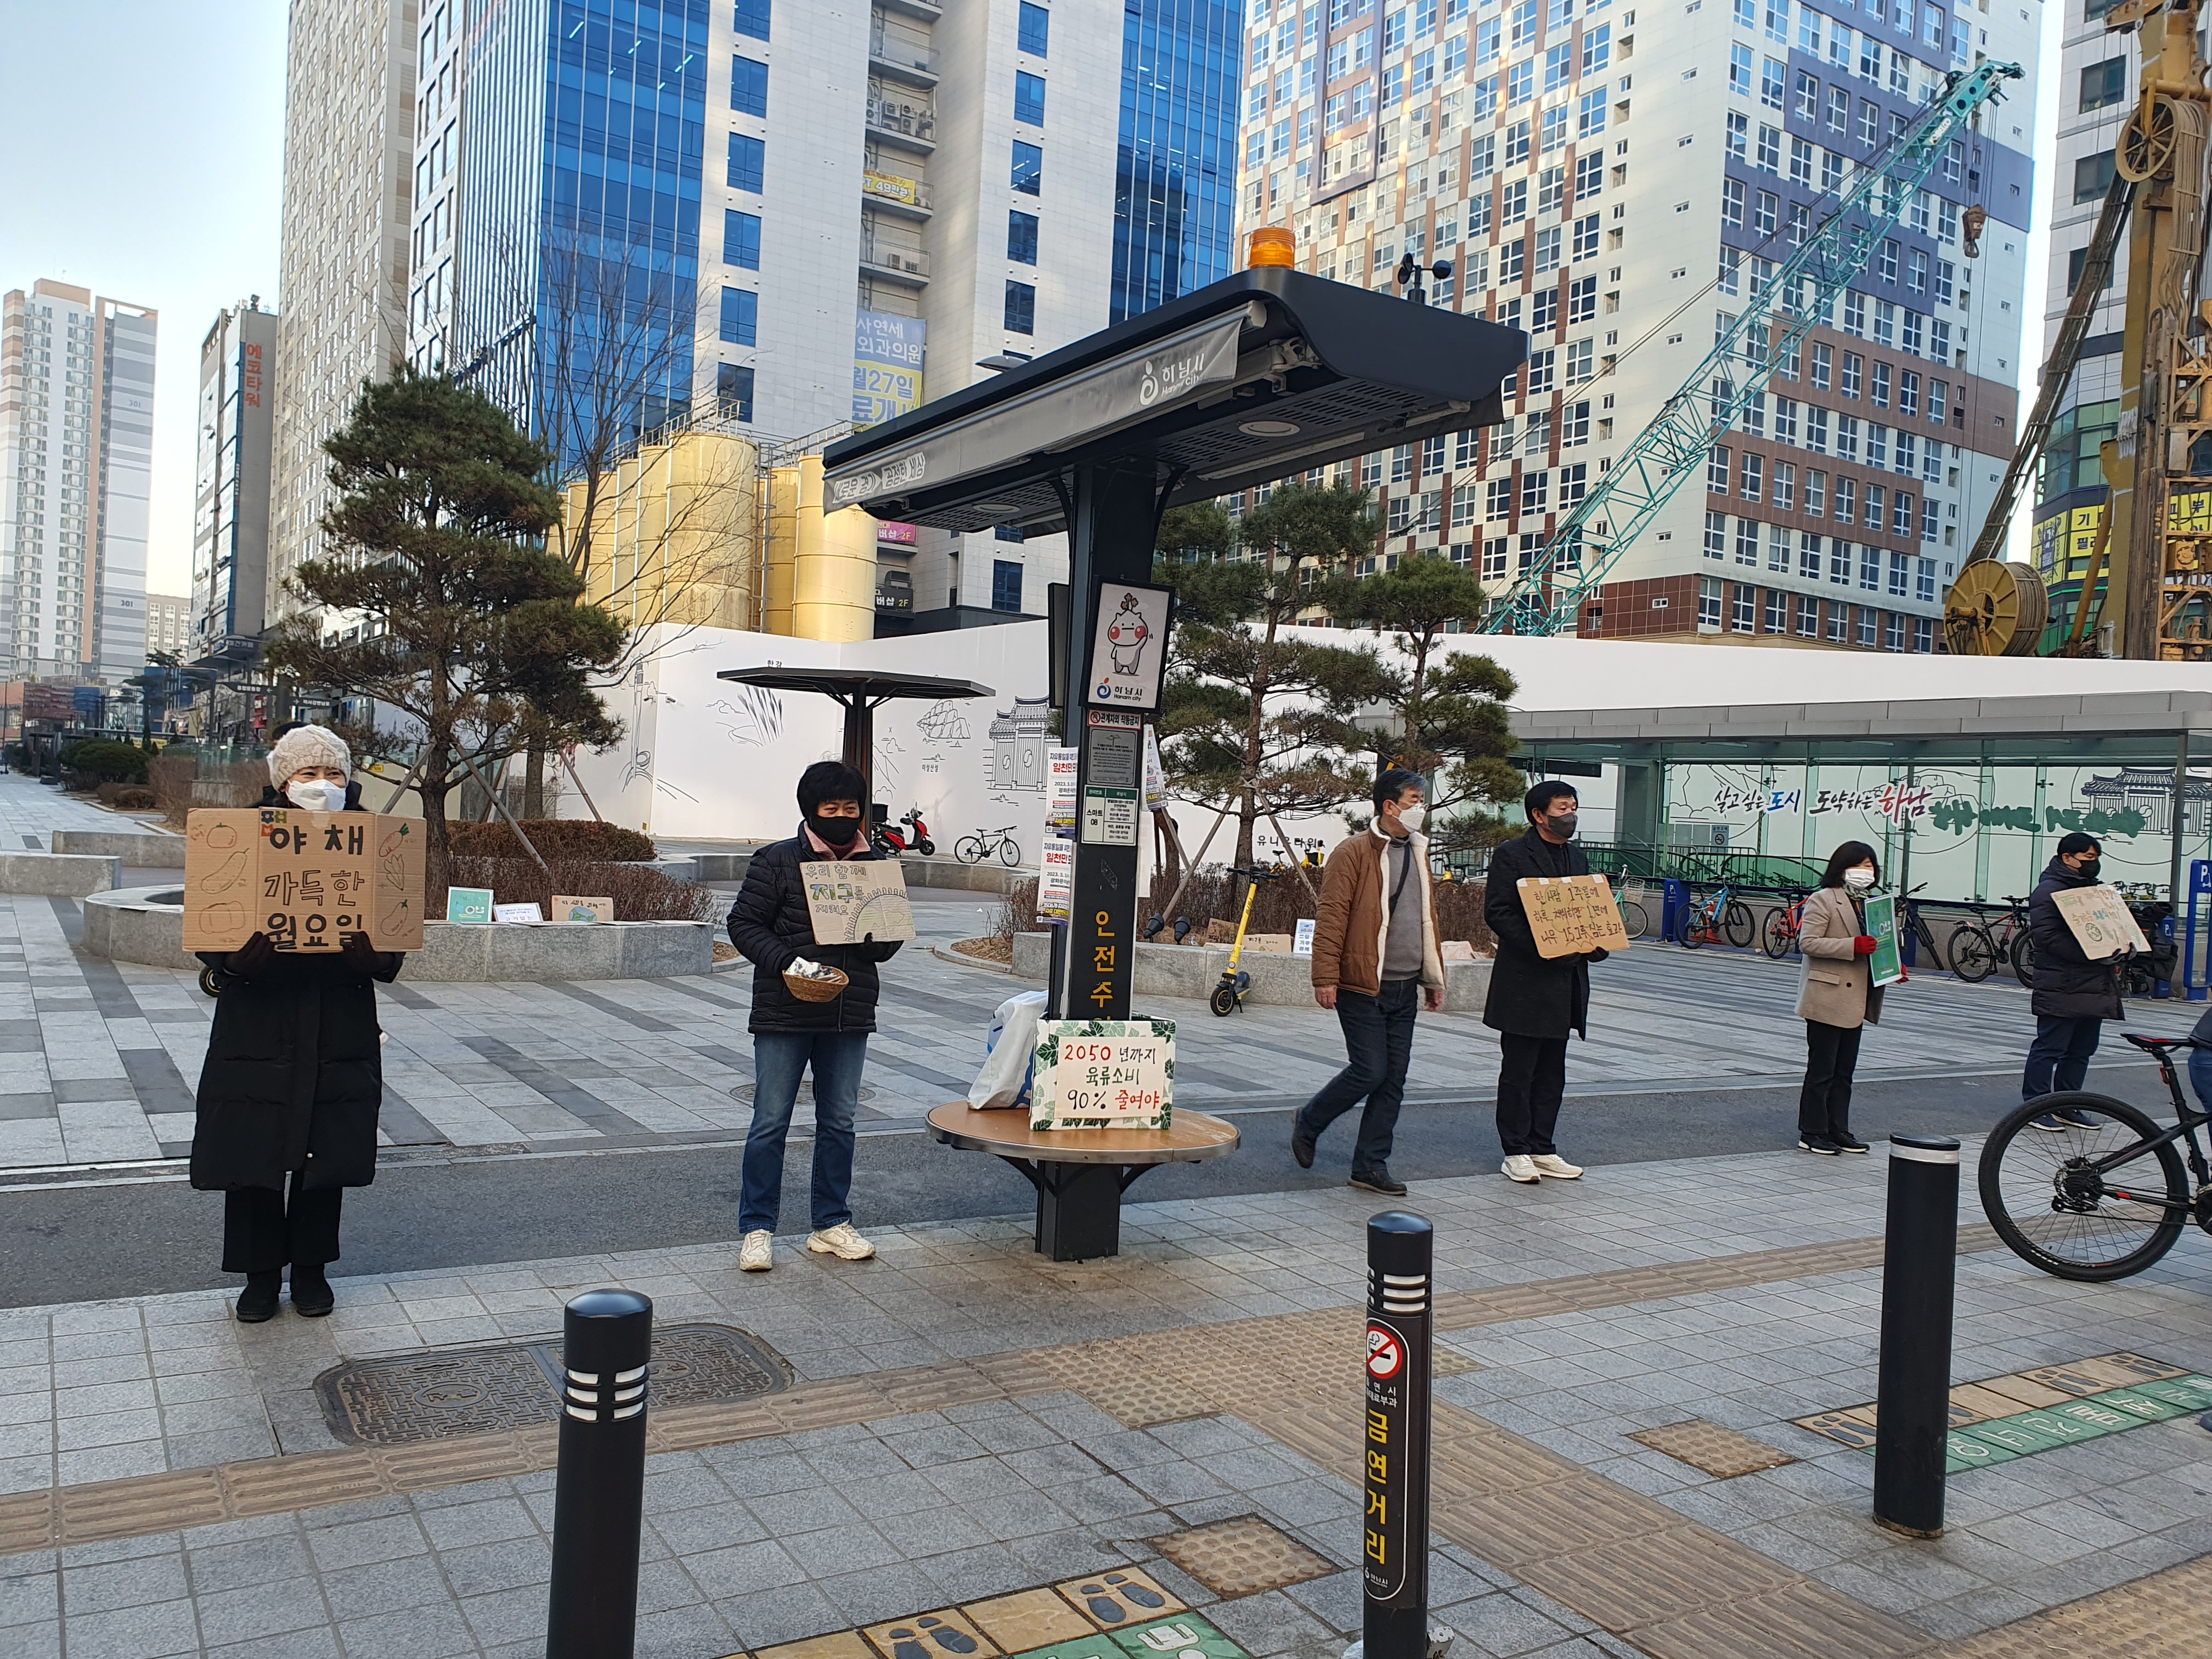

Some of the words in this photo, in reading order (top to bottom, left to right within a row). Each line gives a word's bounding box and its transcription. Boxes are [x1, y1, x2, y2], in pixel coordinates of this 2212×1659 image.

[856, 318, 904, 339] 사연세
[857, 336, 922, 365] 외과의원
[246, 343, 263, 408] 에코타워
[1161, 352, 1205, 383] 하남시
[852, 394, 915, 422] 료개
[834, 478, 858, 501] 새로운
[859, 473, 876, 494] 경기
[884, 461, 907, 488] 공정한
[909, 454, 924, 479] 세상
[1114, 686, 1142, 696] 하남시
[1101, 713, 1119, 724] 관계자외
[1120, 714, 1139, 726] 작동금지
[1053, 763, 1072, 772] 일천만
[1086, 809, 1103, 817] 스마트
[1767, 789, 1802, 814] 도시
[1809, 790, 1875, 815] 도약하는
[1878, 783, 1933, 823] 하남
[269, 824, 363, 855] 야채
[1043, 843, 1063, 851] 자유통일을
[1046, 853, 1068, 864] 일천만
[806, 864, 831, 878] 우리
[834, 864, 867, 879] 함께
[264, 870, 365, 906] 가득한
[810, 883, 864, 904] 지구를
[1533, 890, 1546, 905] 한
[1547, 888, 1561, 902] 사람
[1567, 885, 1600, 901] 1주일에
[815, 904, 849, 916] 지켜요
[1533, 909, 1549, 923] 하루
[1587, 904, 1609, 918] 1년에
[267, 912, 362, 950] 월요일
[1541, 929, 1558, 945] 나무
[1562, 924, 1588, 942] 15그루
[1589, 921, 1606, 944] 심는
[1605, 921, 1623, 936] 효과
[1090, 910, 1115, 1020] 안전주
[1064, 1044, 1111, 1061] 2050
[1119, 1046, 1156, 1064] 년까지
[1085, 1066, 1139, 1087] 육류소비
[1067, 1089, 1107, 1110] 90%
[1114, 1089, 1160, 1110] 줄여야
[1367, 1409, 1389, 1565] 금연거리
